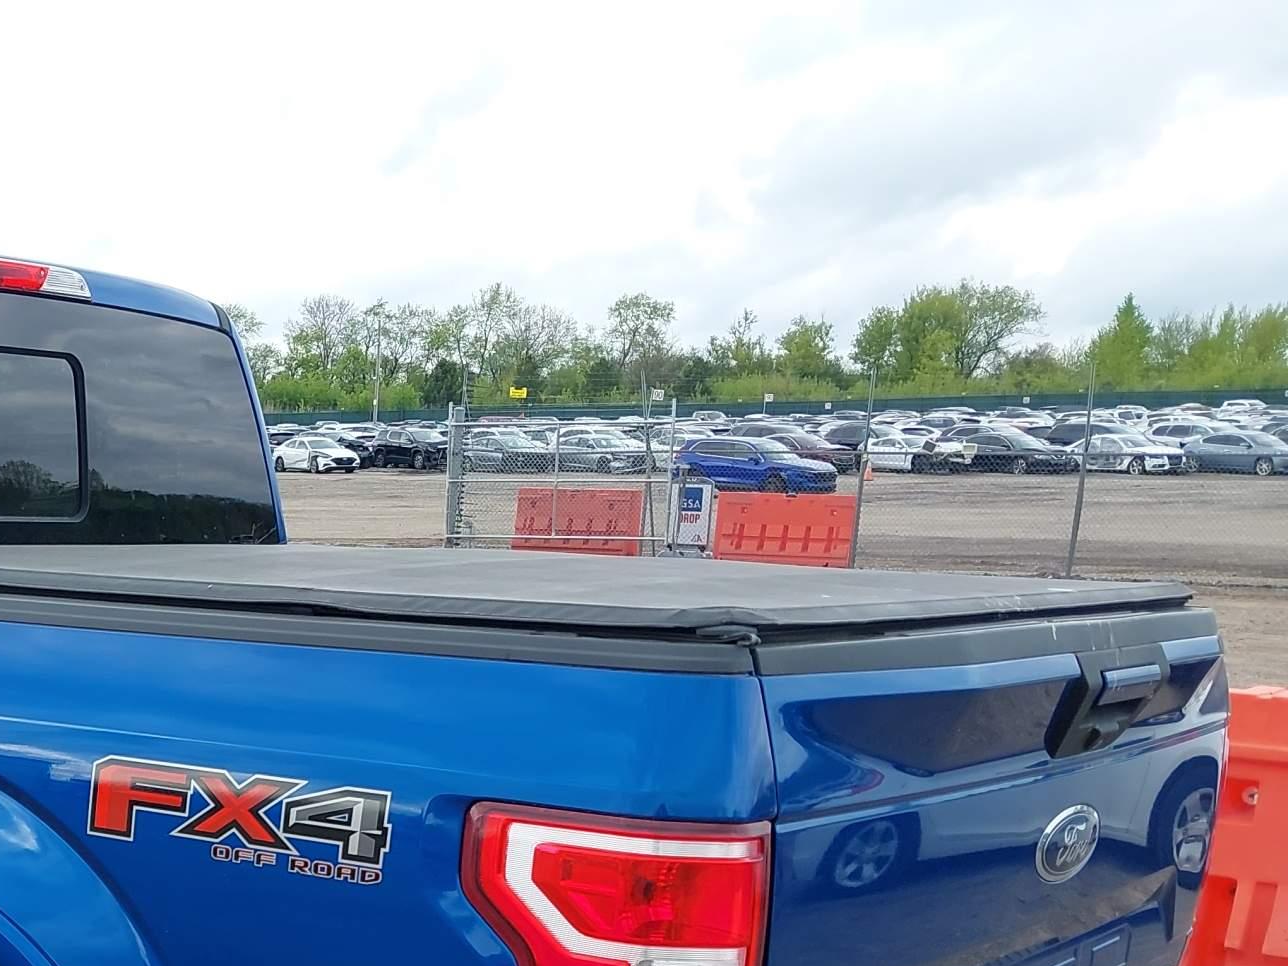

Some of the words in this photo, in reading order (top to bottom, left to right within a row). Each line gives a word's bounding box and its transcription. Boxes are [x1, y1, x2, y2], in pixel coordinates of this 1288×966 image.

[87, 755, 393, 868] FX4
[211, 844, 278, 868] OFF
[288, 856, 383, 885] ROAD
[1056, 821, 1090, 867] Ford
